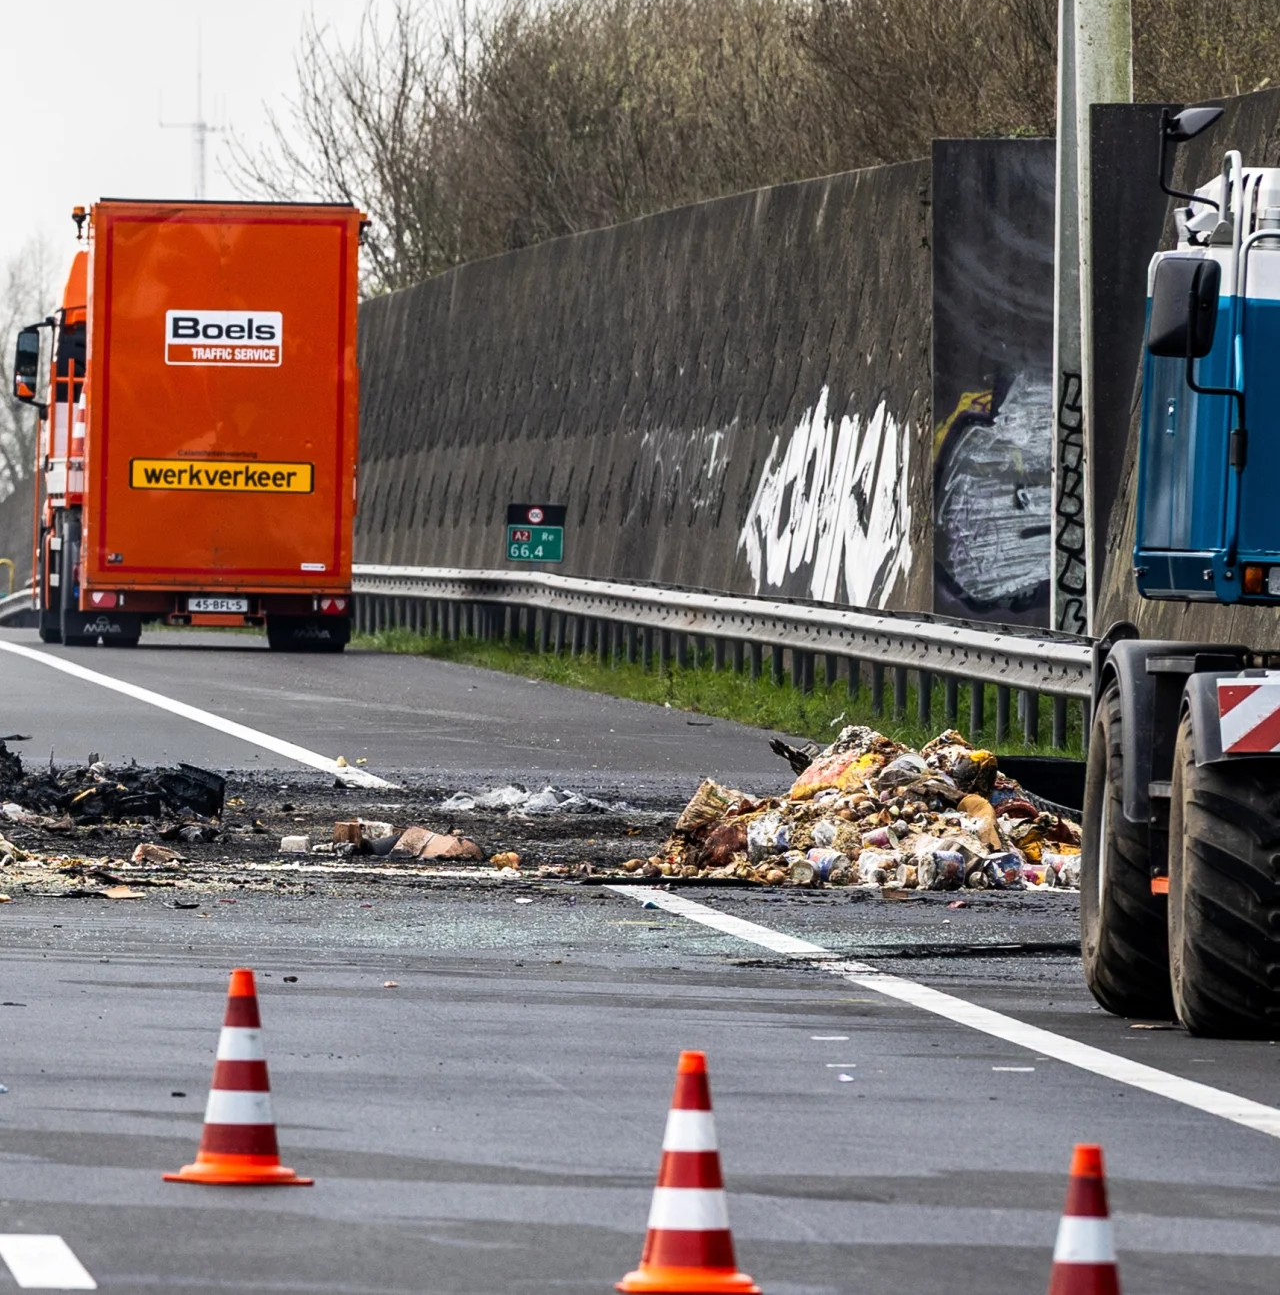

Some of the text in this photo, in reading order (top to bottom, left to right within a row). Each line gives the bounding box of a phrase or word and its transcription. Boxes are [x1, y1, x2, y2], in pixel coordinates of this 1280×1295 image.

[172, 316, 277, 341] Boels
[192, 347, 277, 361] TRAFFIC SERVICE
[143, 463, 298, 488] werkverkeer
[515, 530, 555, 542] A2 Re
